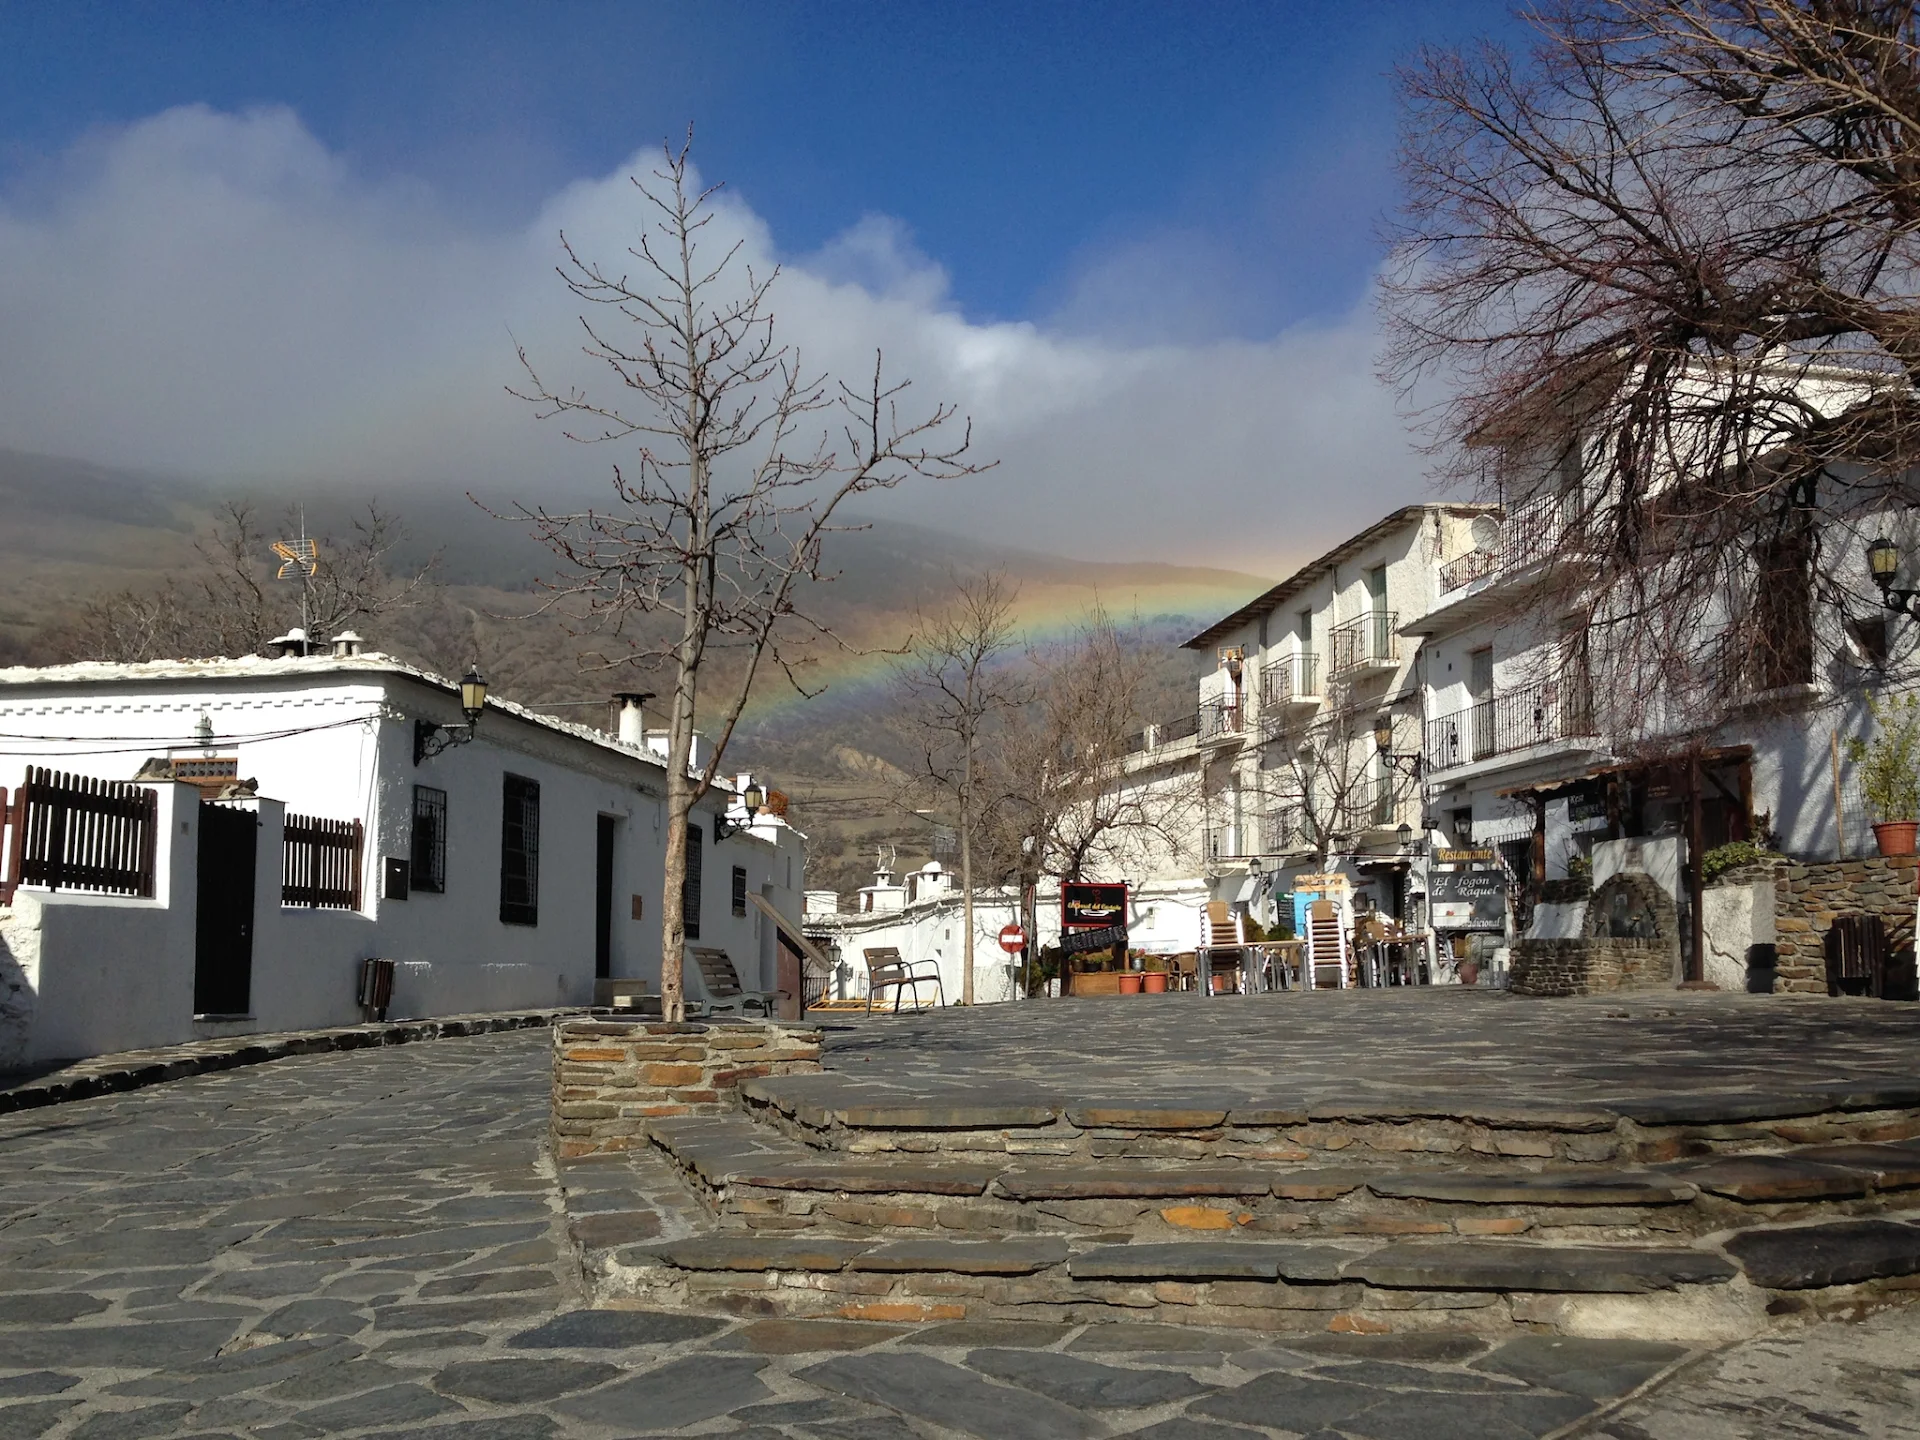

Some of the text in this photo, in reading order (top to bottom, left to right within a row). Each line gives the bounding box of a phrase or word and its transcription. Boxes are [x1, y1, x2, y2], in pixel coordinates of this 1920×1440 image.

[1438, 848, 1493, 862] Restaurante
[1433, 875, 1490, 888] El fogón
[1431, 885, 1500, 898] de Raquel
